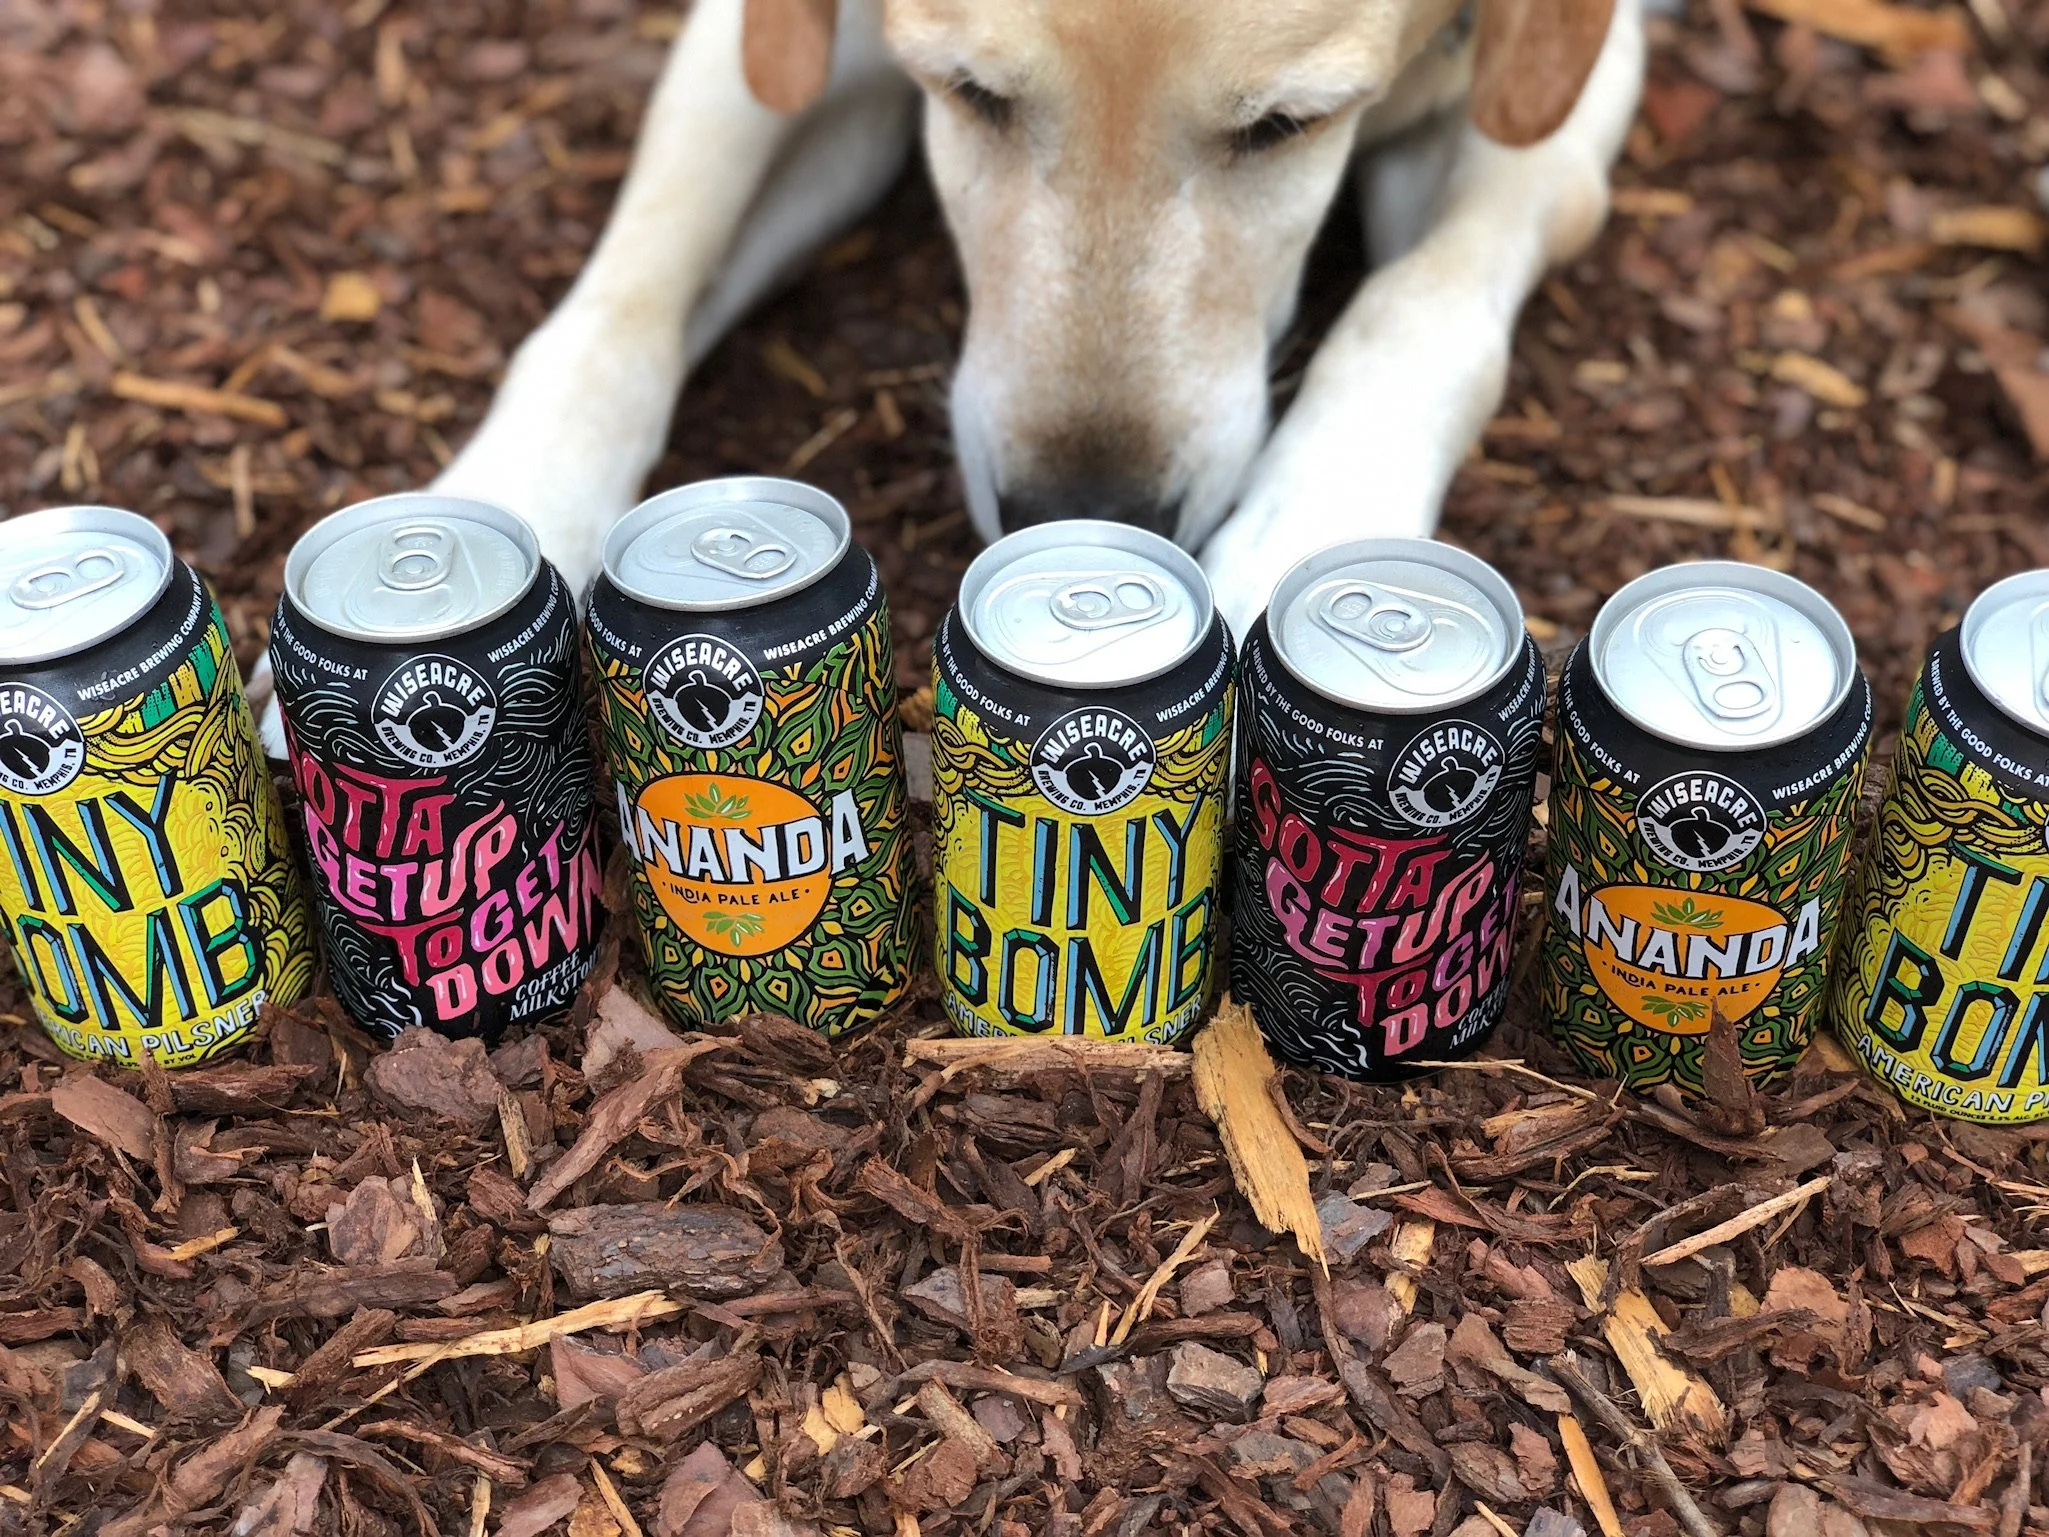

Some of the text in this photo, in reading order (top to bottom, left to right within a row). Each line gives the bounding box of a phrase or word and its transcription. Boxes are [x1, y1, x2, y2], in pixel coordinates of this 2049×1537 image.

[77, 667, 140, 700] WISEACRE
[139, 634, 184, 674] BREWING
[180, 595, 202, 635] COMPANY
[283, 627, 296, 646] THE
[293, 641, 318, 664] GOOD
[317, 657, 352, 678] FOLKS
[353, 668, 369, 681] AT
[487, 627, 535, 663] WISEACRE
[531, 594, 559, 633] BREWING
[589, 607, 642, 658] GOOD FOLKS AT
[763, 629, 828, 660] WISEACRE
[827, 598, 868, 636] BREWING
[381, 662, 487, 718] WISEACRE
[650, 642, 753, 692] WISEACRE
[942, 643, 951, 658] BY
[947, 656, 959, 676] THE
[955, 673, 979, 700] GOOD
[979, 696, 1013, 720] FOLKS
[1014, 714, 1030, 727] AT
[1156, 688, 1205, 722] WISEACRE
[1204, 652, 1228, 693] BREWING
[0, 690, 71, 740] EACRE
[1252, 647, 1384, 750] BREWED BY THE GOOD FOLKS AT
[1498, 680, 1531, 721] WISEACRE
[1931, 658, 1944, 697] BREWED
[1938, 695, 1951, 711] BY
[1946, 709, 1963, 731] THE
[1961, 728, 1993, 757] GOOD
[1993, 753, 2033, 780] FOLKS
[419, 753, 437, 764] CO.
[1040, 714, 1148, 764] WISEACRE
[1398, 727, 1498, 784] WISEACRE
[1564, 688, 1574, 710] THE
[1569, 711, 1591, 743] GOOD
[1590, 742, 1622, 774] FOLKS
[1623, 770, 1640, 784] AT
[1772, 765, 1833, 800] WISEACRE
[1834, 721, 1868, 770] BREWING
[12, 779, 28, 790] CO.
[1038, 770, 1069, 804] BREWING
[1069, 803, 1086, 811] CO.
[1647, 779, 1757, 828] WISEACRE
[0, 768, 183, 915] INY
[617, 780, 869, 885] ANANDA
[962, 785, 1206, 930] TINY
[356, 819, 564, 987] TO GET
[670, 883, 800, 905] INDIA PALE ALE
[1554, 862, 1820, 978] ANANDA
[1940, 838, 2049, 986] TI
[947, 879, 1212, 1037] BOMB
[1314, 862, 1520, 1027] TO GET
[509, 986, 565, 1021] MILK
[515, 948, 580, 1001] COFFEE
[1611, 965, 1750, 996] INDIA PALE ALE
[1118, 994, 1202, 1044] SNER
[1857, 1035, 2014, 1112] AMERICAN
[1923, 1100, 1947, 1112] FLUID
[1950, 1109, 1986, 1120] OUNCES
